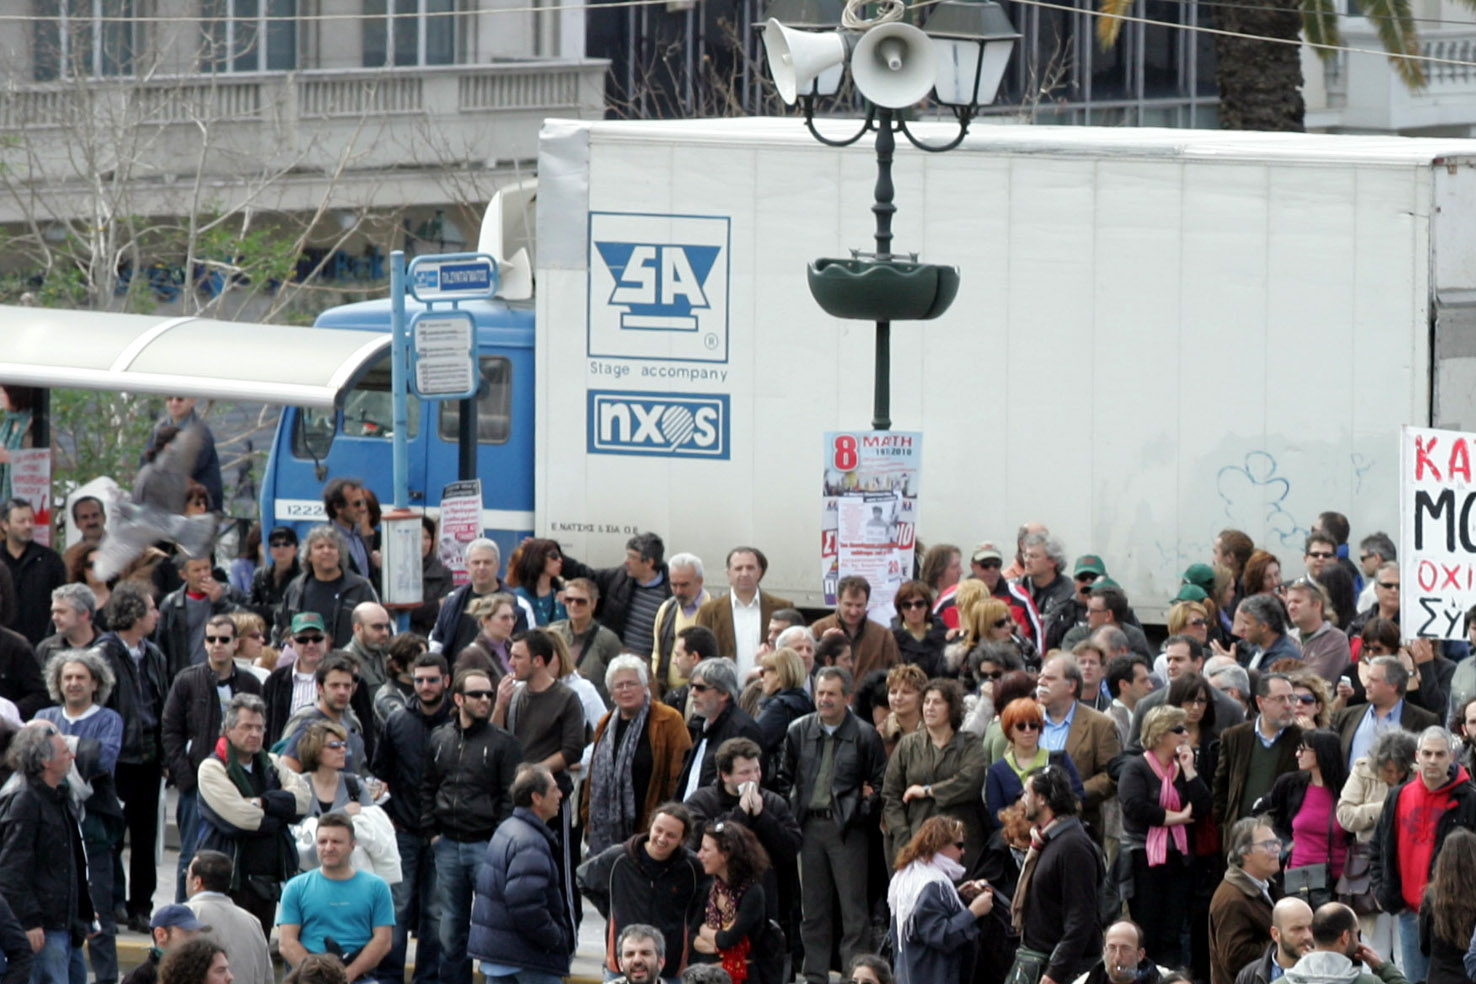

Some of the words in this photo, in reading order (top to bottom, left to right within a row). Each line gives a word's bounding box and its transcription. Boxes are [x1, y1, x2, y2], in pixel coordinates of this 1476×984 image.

[611, 246, 707, 306] SA
[590, 361, 630, 379] Stage
[641, 363, 728, 382] accompany
[834, 435, 857, 470] 8
[1418, 560, 1473, 592] ΟΧΙ
